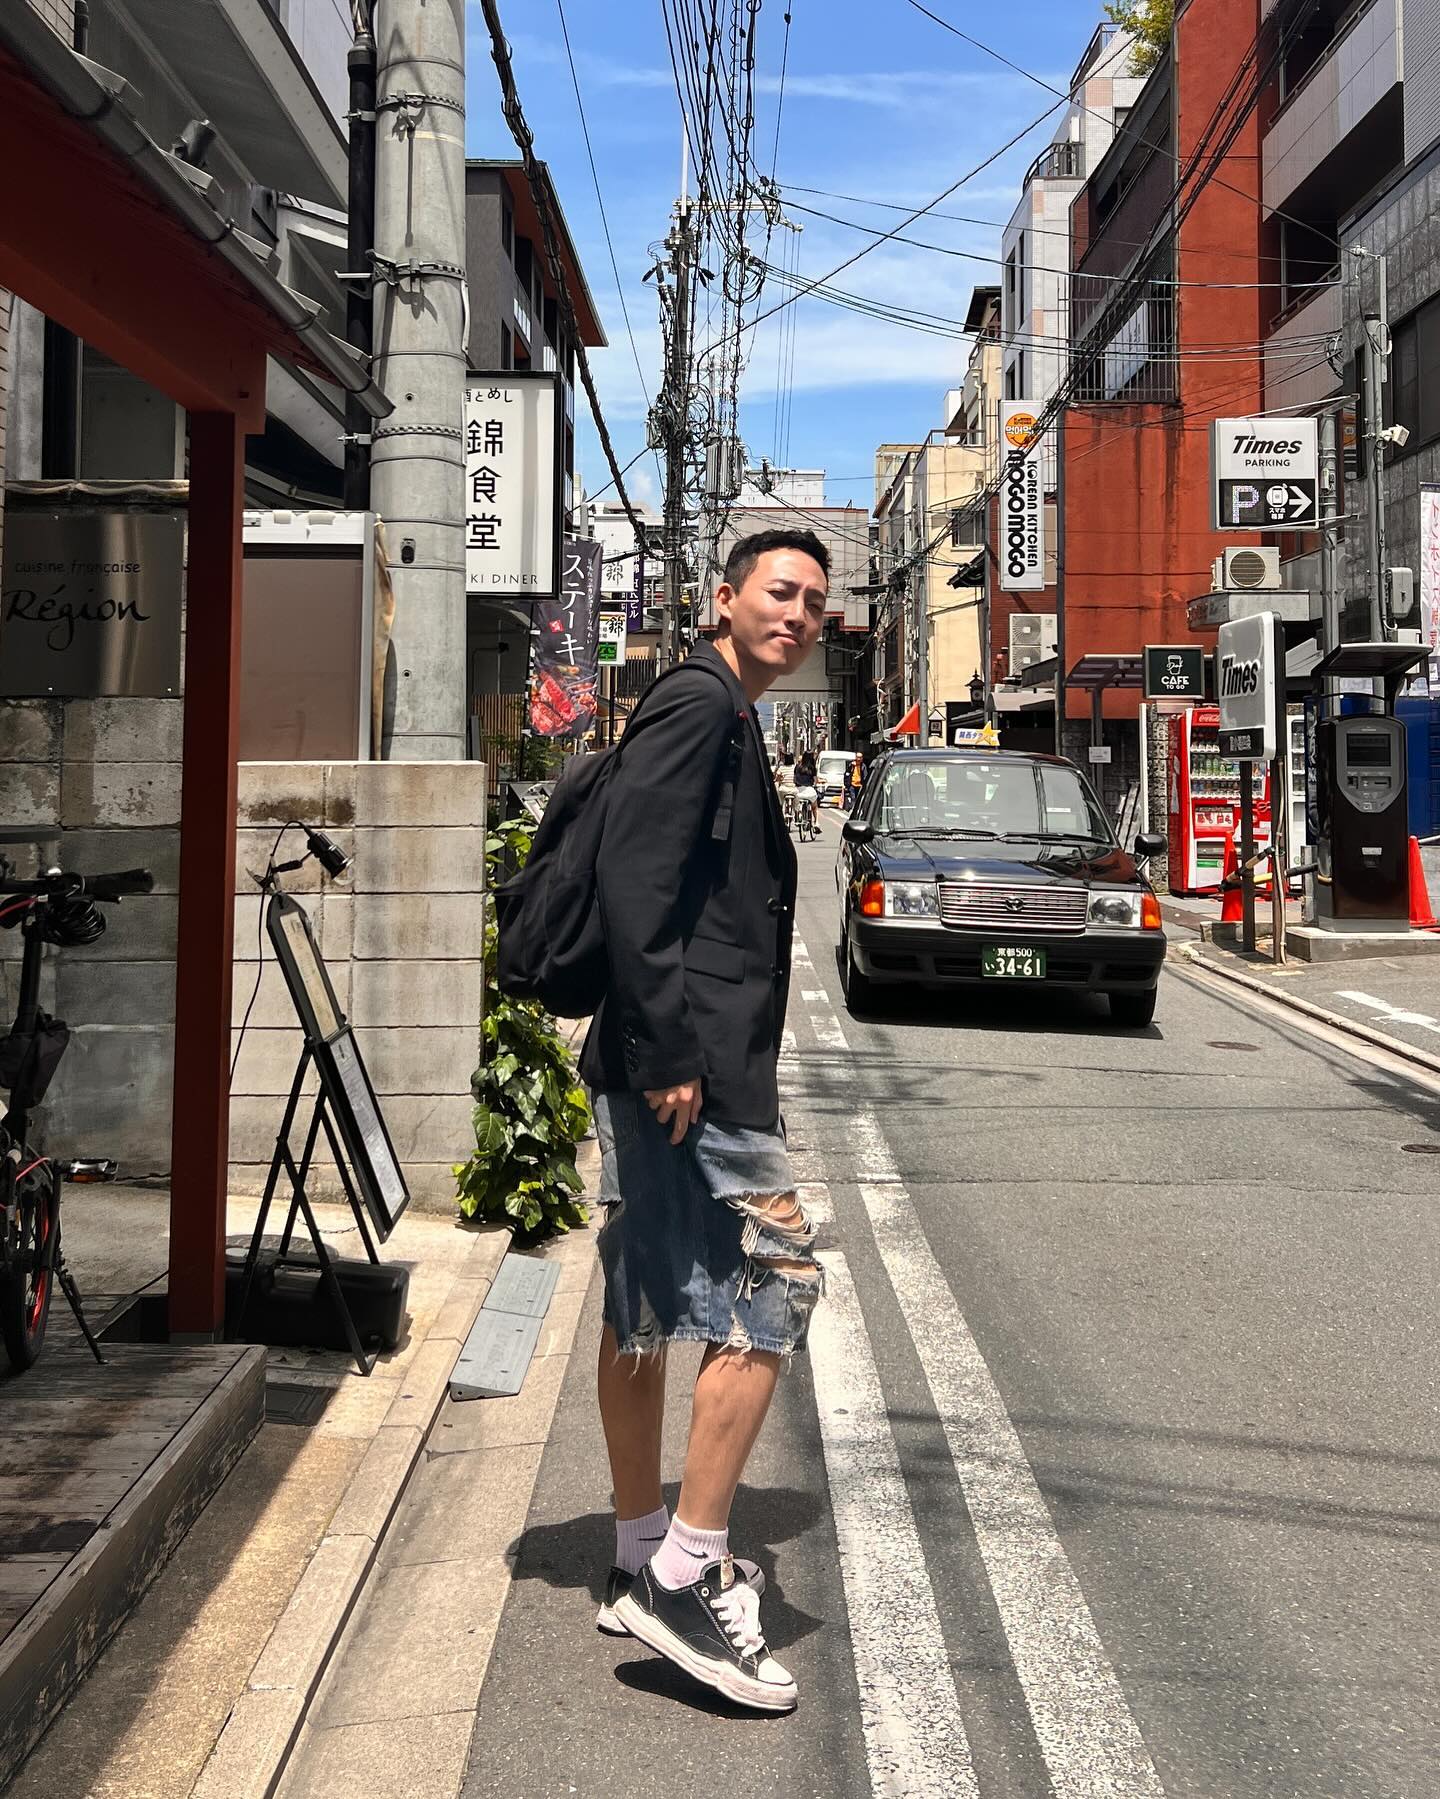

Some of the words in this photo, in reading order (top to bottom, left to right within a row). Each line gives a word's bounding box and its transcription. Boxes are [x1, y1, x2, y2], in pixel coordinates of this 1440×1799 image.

[1233, 436, 1302, 454] Times
[1245, 459, 1291, 467] PARKING
[466, 419, 503, 549] 錦食堂
[1232, 485, 1260, 524] P
[15, 561, 66, 573] cuisine
[71, 559, 141, 576] française
[492, 574, 538, 584] DINER
[3, 584, 151, 651] Région
[555, 554, 586, 666] ステーキ
[1161, 676, 1190, 685] CAFE
[1222, 658, 1260, 697] Times
[996, 957, 1040, 976] 34-61
